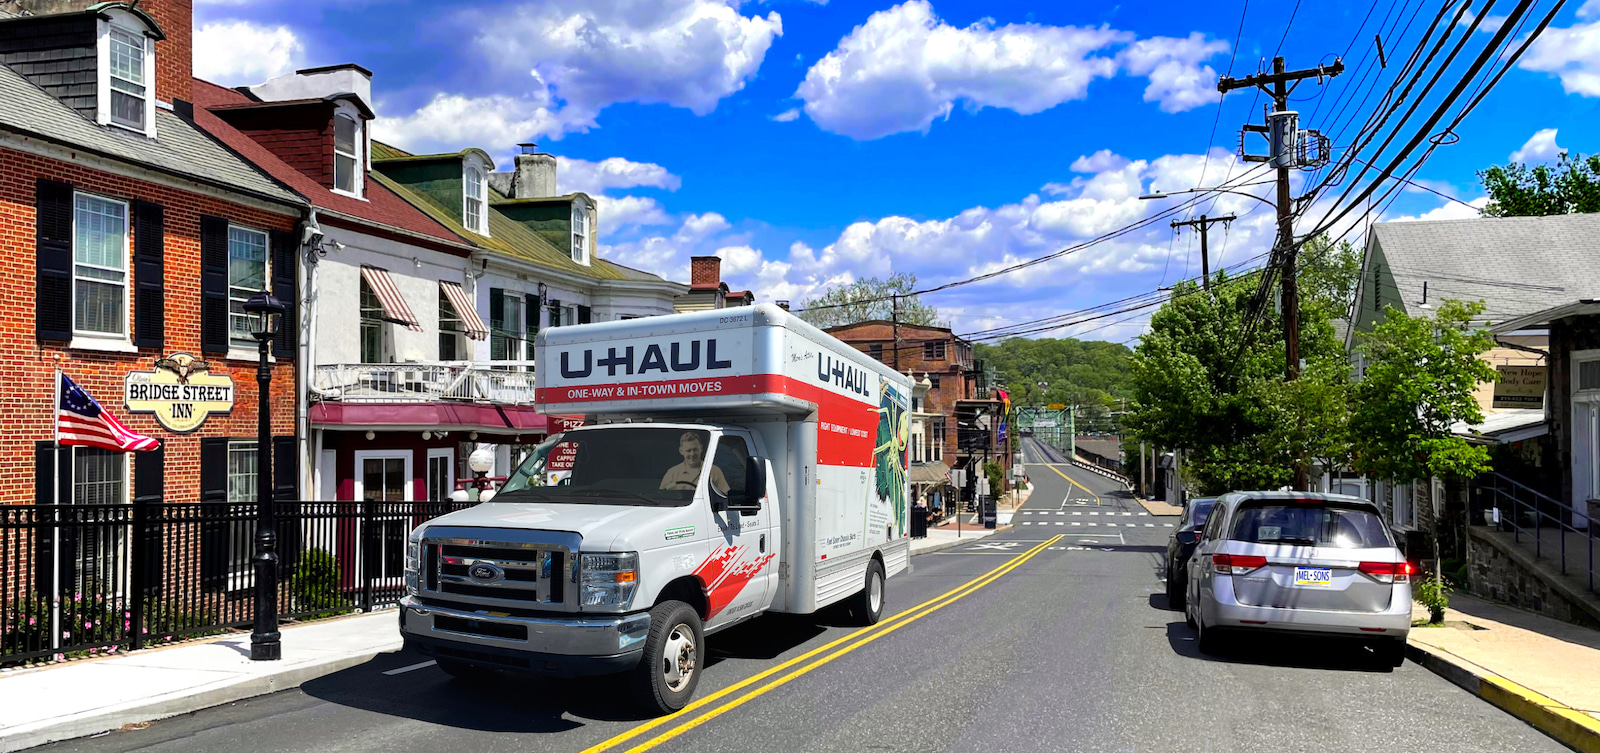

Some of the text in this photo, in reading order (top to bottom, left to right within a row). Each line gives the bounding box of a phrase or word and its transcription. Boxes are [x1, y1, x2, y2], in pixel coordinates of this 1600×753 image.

[719, 316, 729, 324] DC
[560, 338, 732, 379] U-HAUL
[818, 352, 870, 397] U-HAUL
[1520, 368, 1542, 378] Hope
[1500, 378, 1519, 386] Body
[130, 384, 230, 401] BRIDGE STREET
[567, 381, 722, 399] ONE-WAY & IN-TOWN MOVES
[172, 403, 193, 418] INN
[475, 568, 490, 578] Ford
